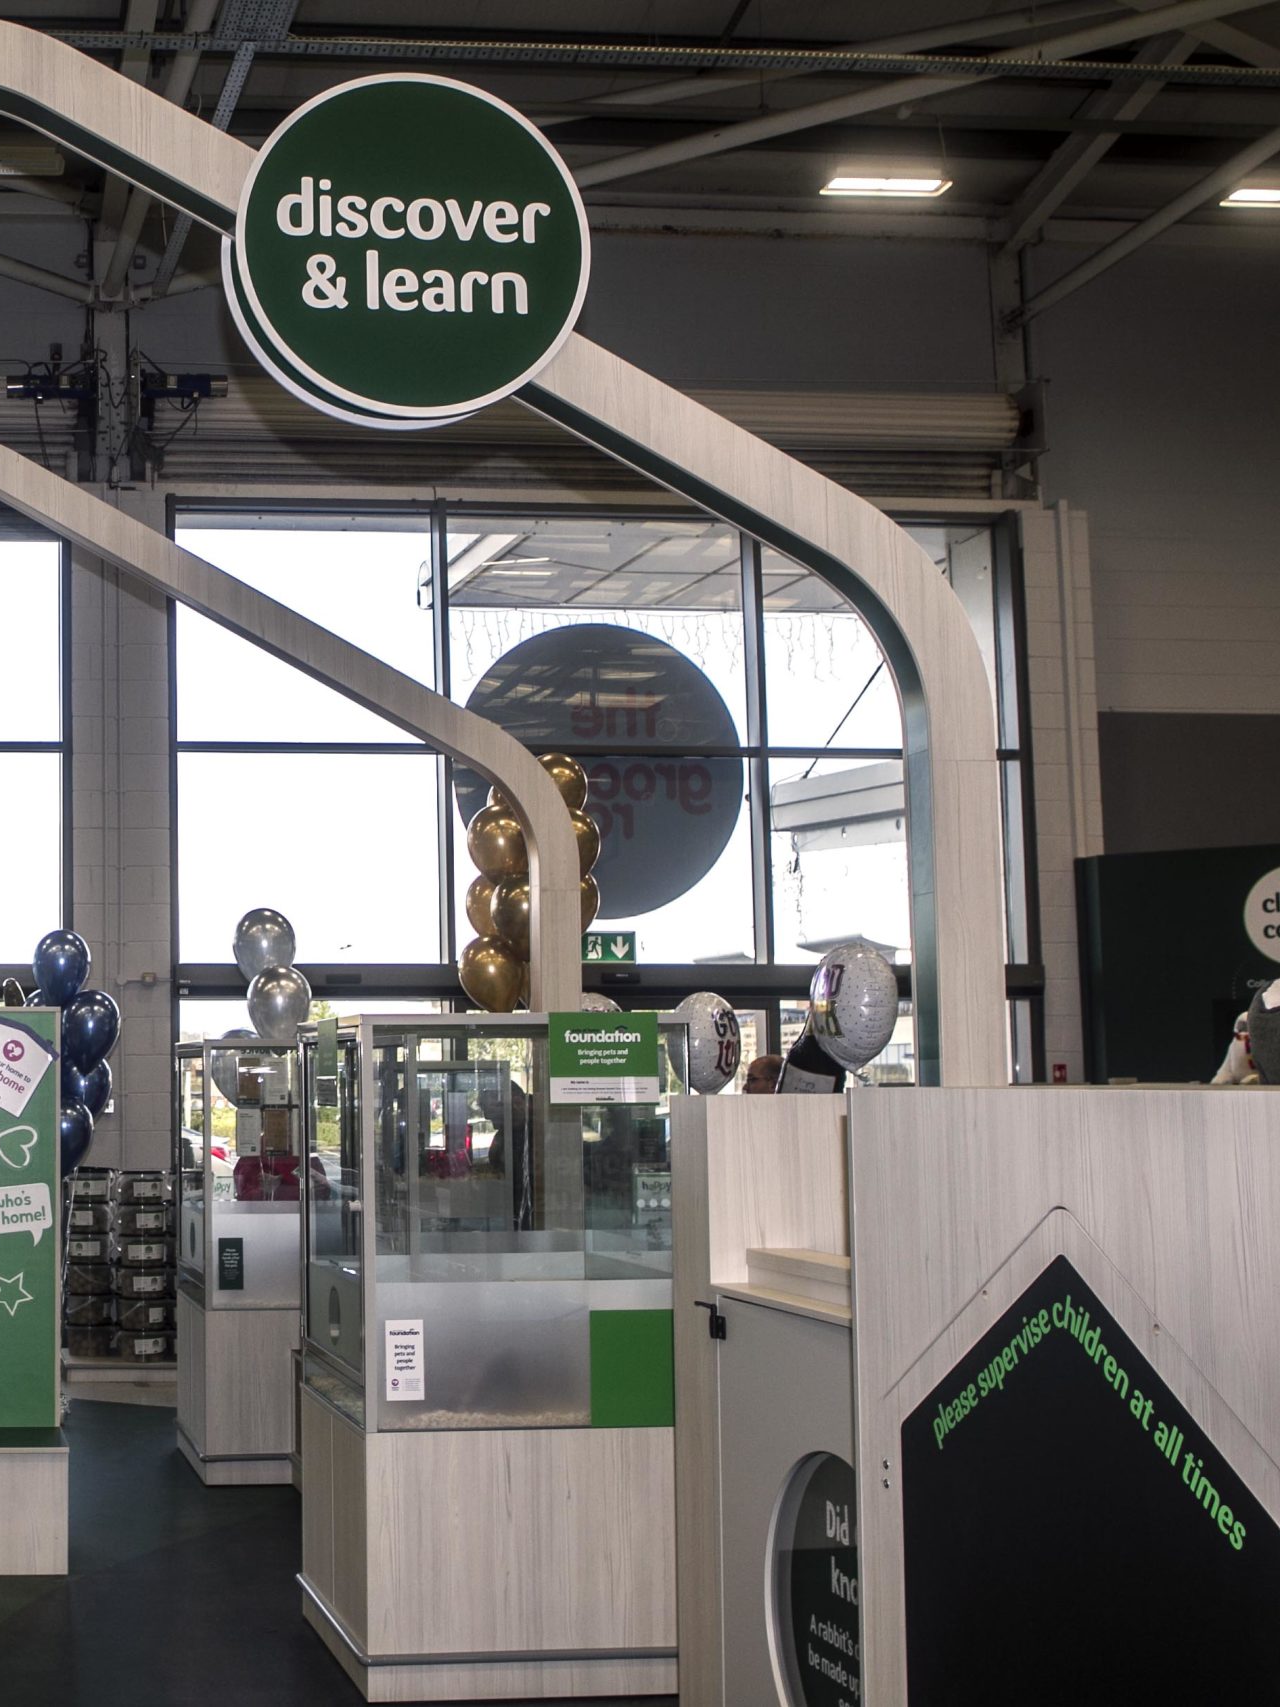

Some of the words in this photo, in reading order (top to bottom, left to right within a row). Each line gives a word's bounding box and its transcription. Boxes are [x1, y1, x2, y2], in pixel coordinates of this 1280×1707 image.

[276, 176, 551, 243] discover
[301, 253, 349, 309] &
[366, 249, 528, 315] learn
[564, 1029, 640, 1043] foundation
[6, 1064, 24, 1079] home
[23, 1075, 31, 1083] to
[600, 1057, 627, 1065] together
[1, 1206, 46, 1225] home!
[933, 1383, 979, 1450] please
[977, 1308, 1051, 1398] supervise
[1052, 1295, 1129, 1399] children
[1130, 1389, 1155, 1431] at
[1154, 1421, 1184, 1466] all
[1182, 1452, 1246, 1550] times
[826, 1500, 850, 1546] Did
[831, 1556, 858, 1606] kno
[810, 1614, 817, 1635] A
[818, 1621, 854, 1657] rabbit's
[808, 1643, 820, 1670] be
[821, 1655, 848, 1688] made
